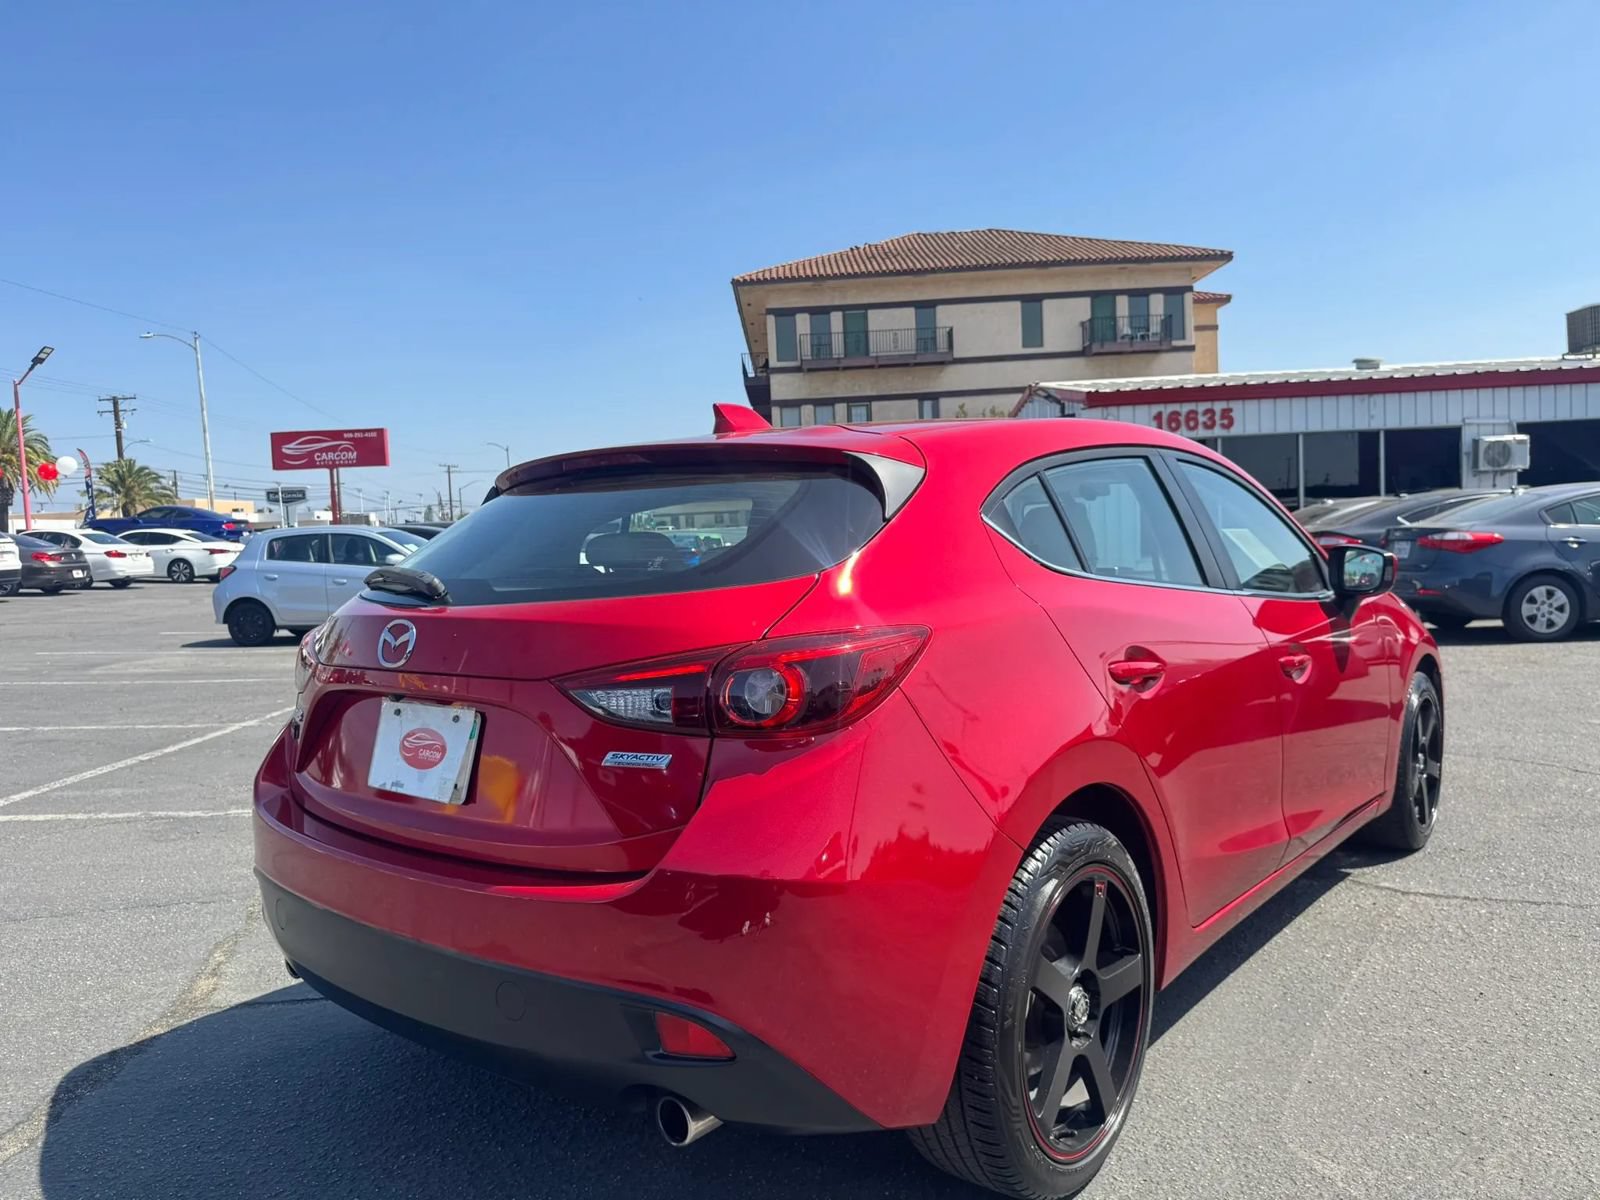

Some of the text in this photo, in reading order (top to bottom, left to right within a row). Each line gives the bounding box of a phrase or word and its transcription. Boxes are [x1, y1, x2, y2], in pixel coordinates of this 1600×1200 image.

[1152, 408, 1234, 432] 16635
[314, 451, 357, 462] CARCOM
[418, 748, 442, 759] CARCOM
[610, 753, 665, 761] SKYACTIV
